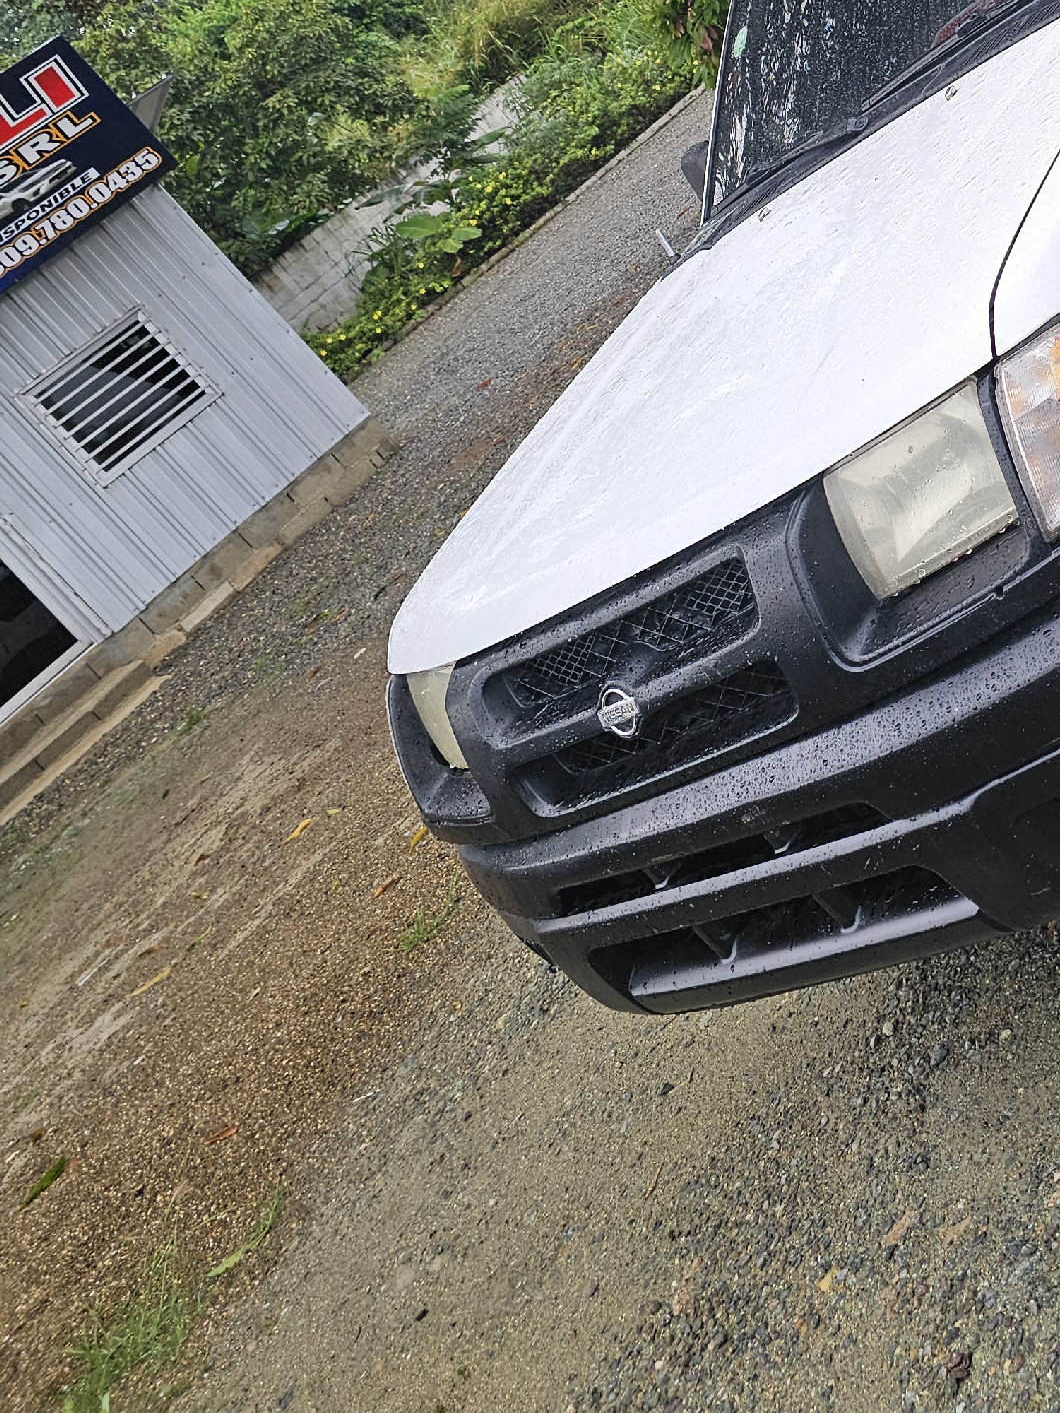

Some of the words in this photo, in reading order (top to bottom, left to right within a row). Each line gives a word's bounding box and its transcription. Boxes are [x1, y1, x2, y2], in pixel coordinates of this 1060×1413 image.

[0, 171, 94, 241] SPONIBLE
[0, 147, 162, 276] 09.780.0435
[600, 700, 635, 725] NISSAN
